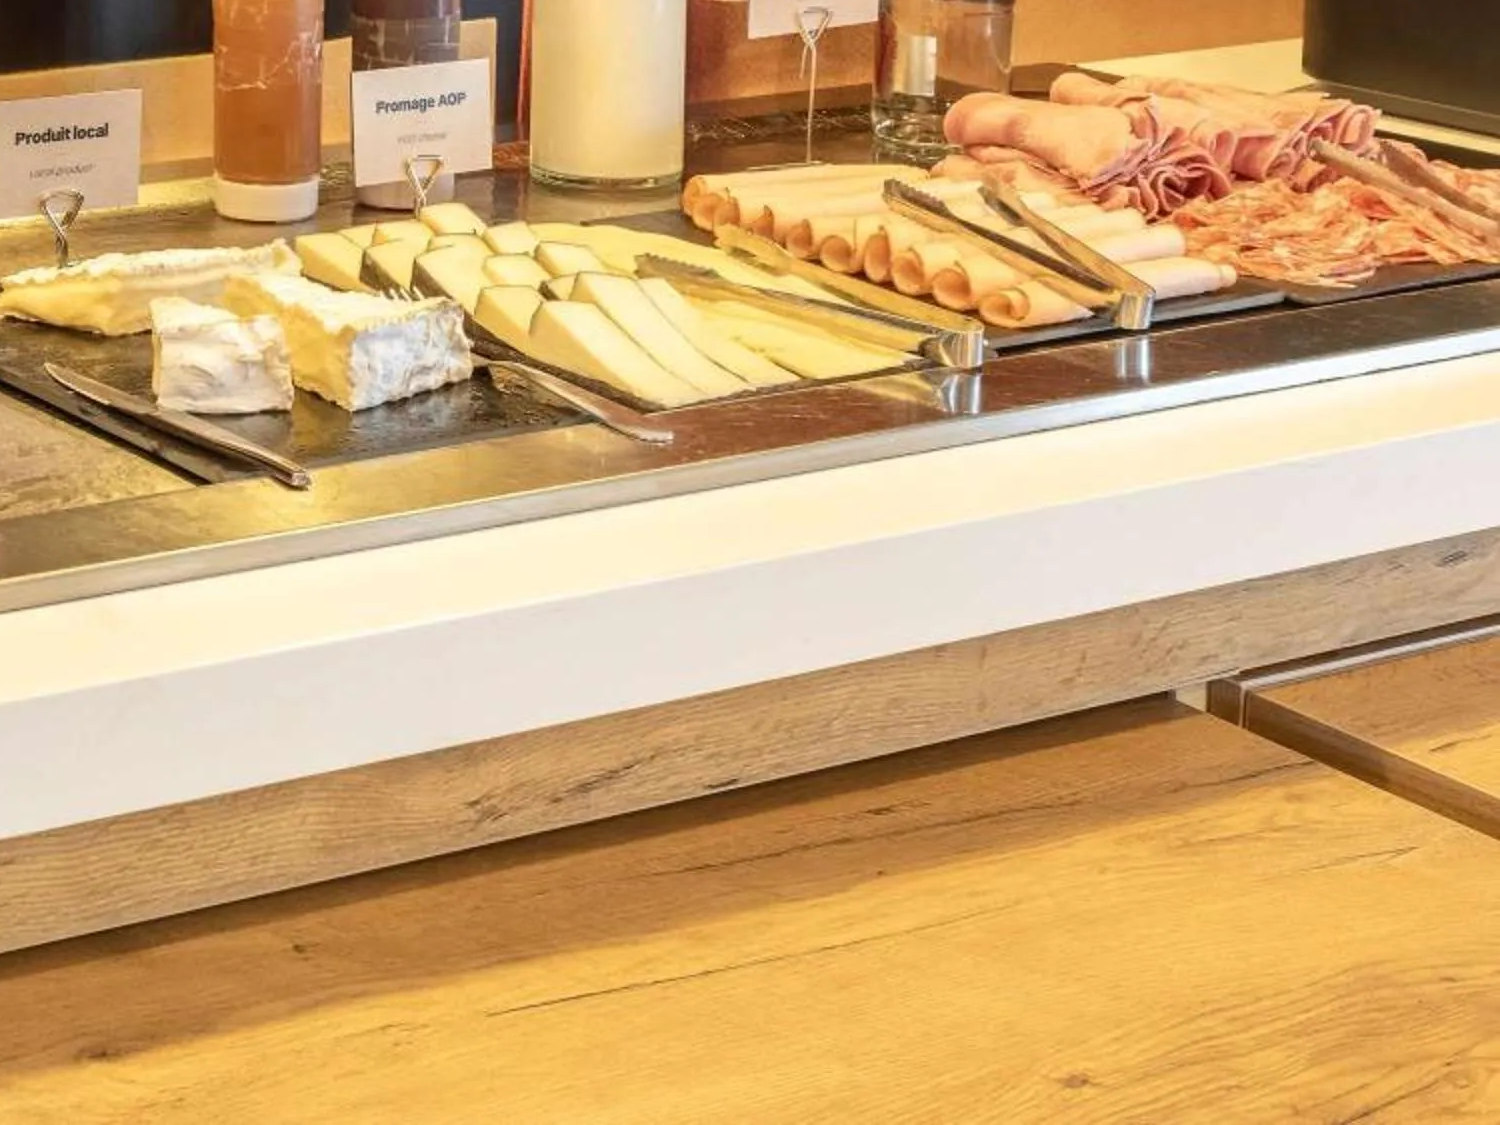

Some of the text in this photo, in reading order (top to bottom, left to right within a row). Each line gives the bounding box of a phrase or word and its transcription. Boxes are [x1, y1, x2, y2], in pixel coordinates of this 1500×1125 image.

[375, 92, 467, 114] Fromage AOP
[15, 123, 109, 146] Produit local
